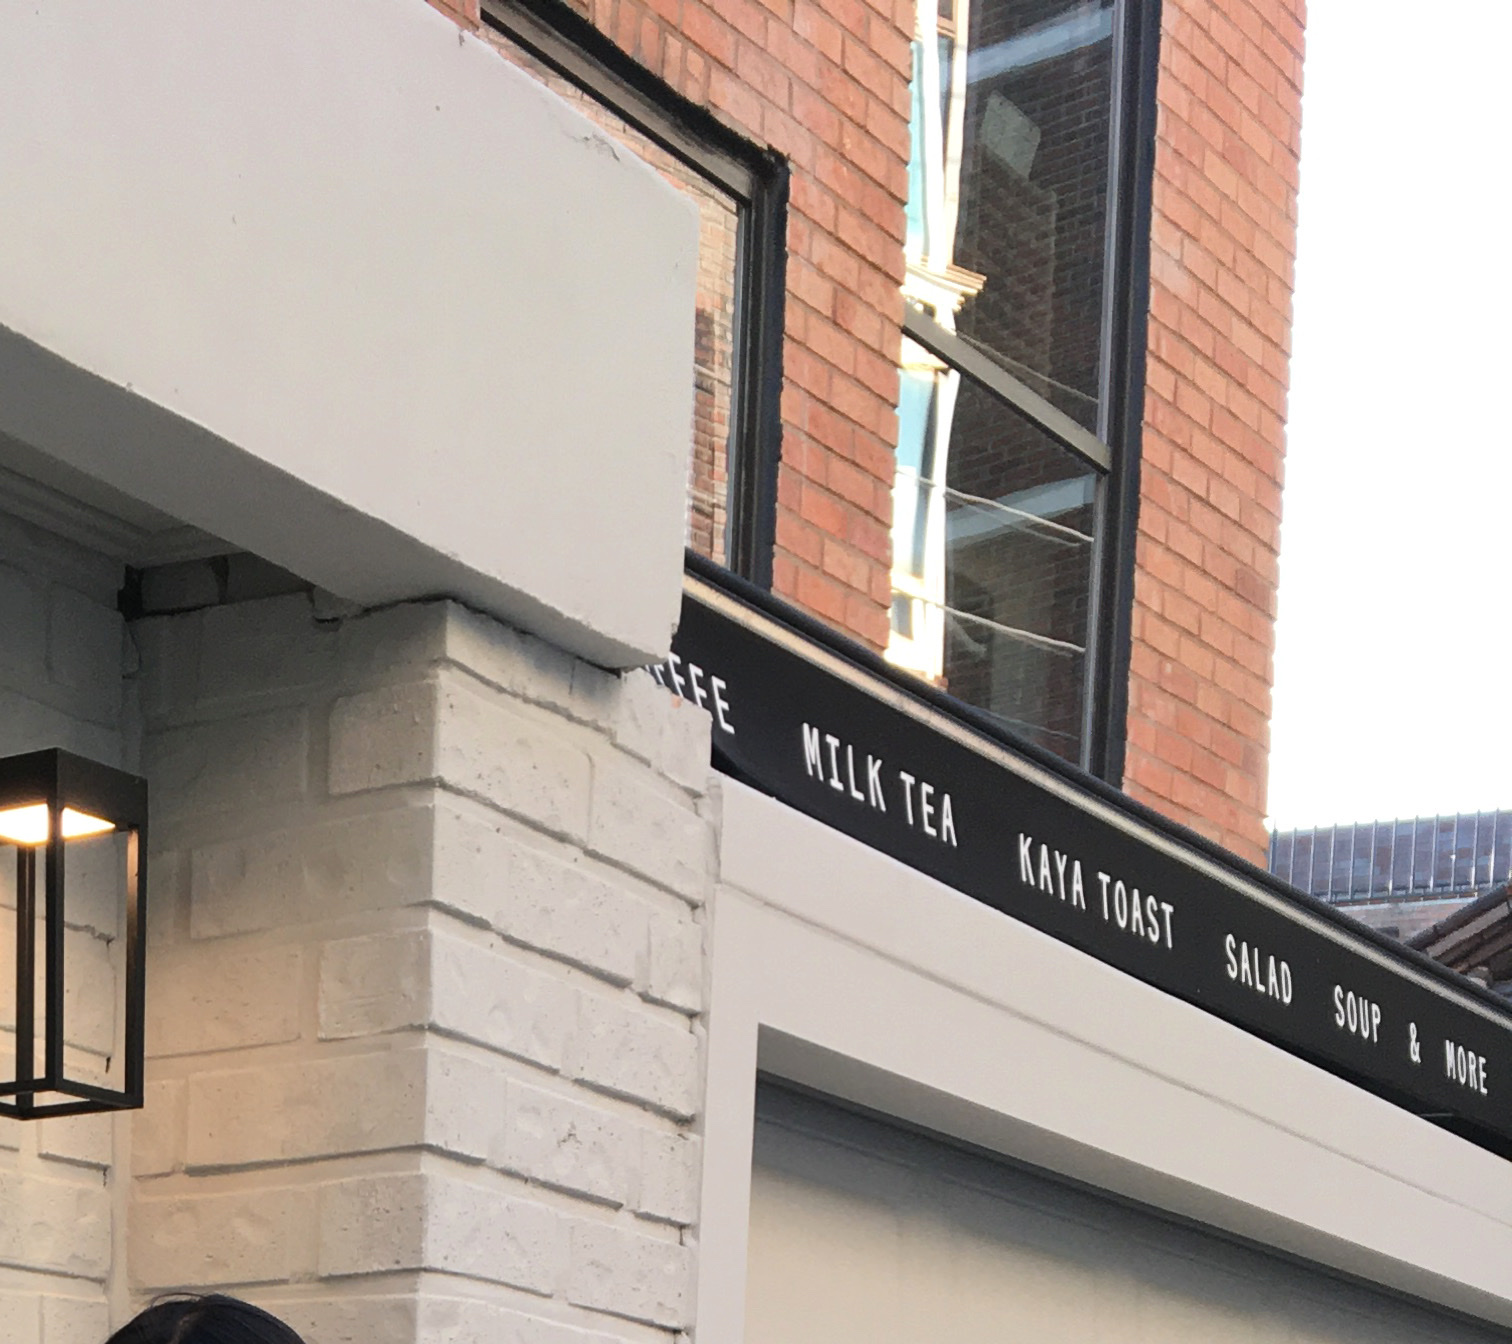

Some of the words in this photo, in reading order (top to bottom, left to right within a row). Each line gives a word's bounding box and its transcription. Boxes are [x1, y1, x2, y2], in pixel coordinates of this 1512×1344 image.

[802, 722, 887, 812] MILK
[899, 770, 958, 848] TEA
[1018, 832, 1087, 911] KAYA
[1097, 871, 1175, 949] TOAST
[1225, 933, 1293, 1005] SALAD
[1334, 984, 1381, 1043] SOUP
[1409, 1022, 1422, 1064] &
[1445, 1039, 1488, 1095] MORE
